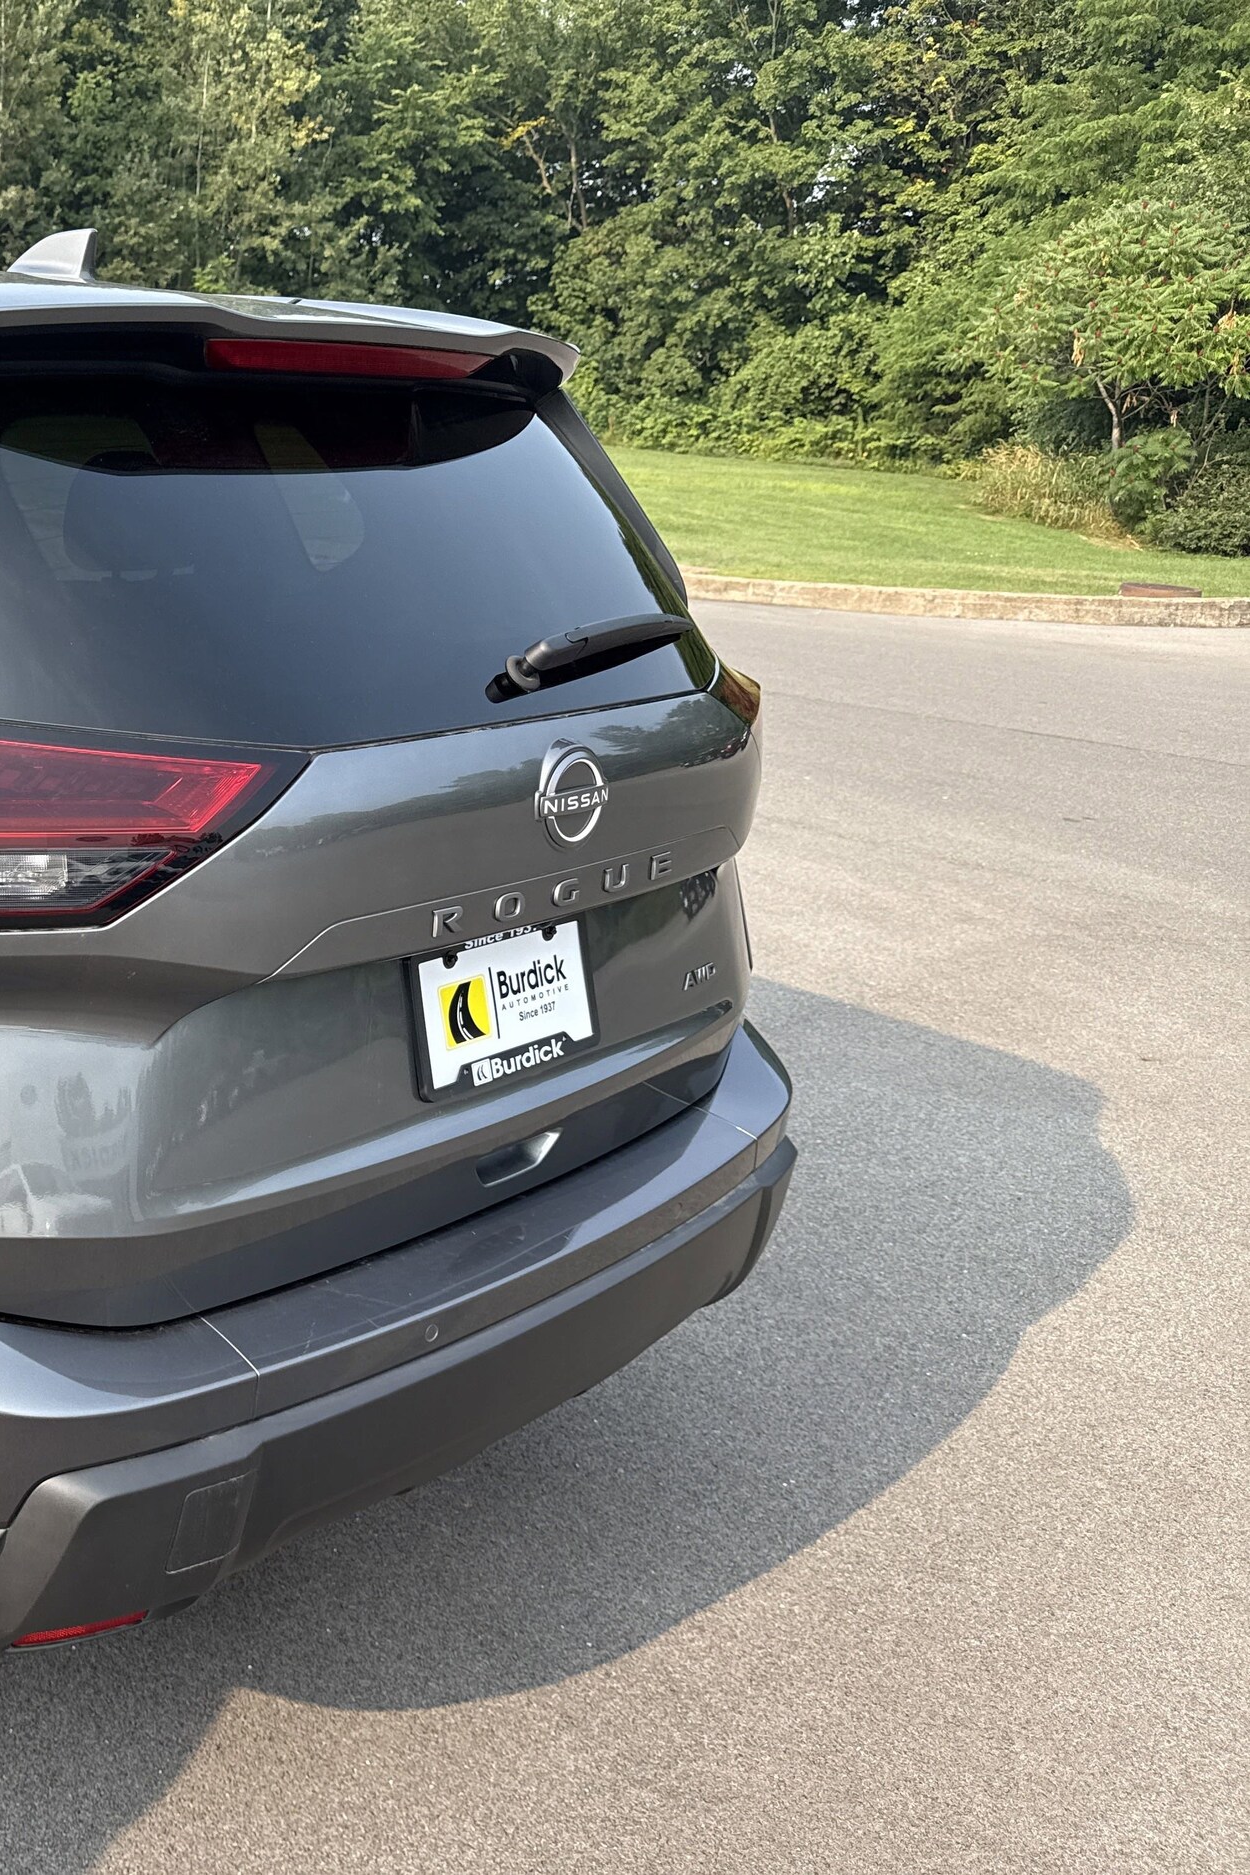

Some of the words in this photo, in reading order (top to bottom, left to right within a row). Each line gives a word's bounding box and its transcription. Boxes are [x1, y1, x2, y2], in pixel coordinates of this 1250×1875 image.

[543, 787, 609, 815] NISSAN
[432, 851, 673, 938] ROGUE
[496, 954, 567, 1000] Burdick
[501, 983, 569, 1012] AUTOMOTIVE
[518, 1008, 539, 1021] Since
[539, 1001, 556, 1015] 1937
[491, 1038, 565, 1079] Burdick
